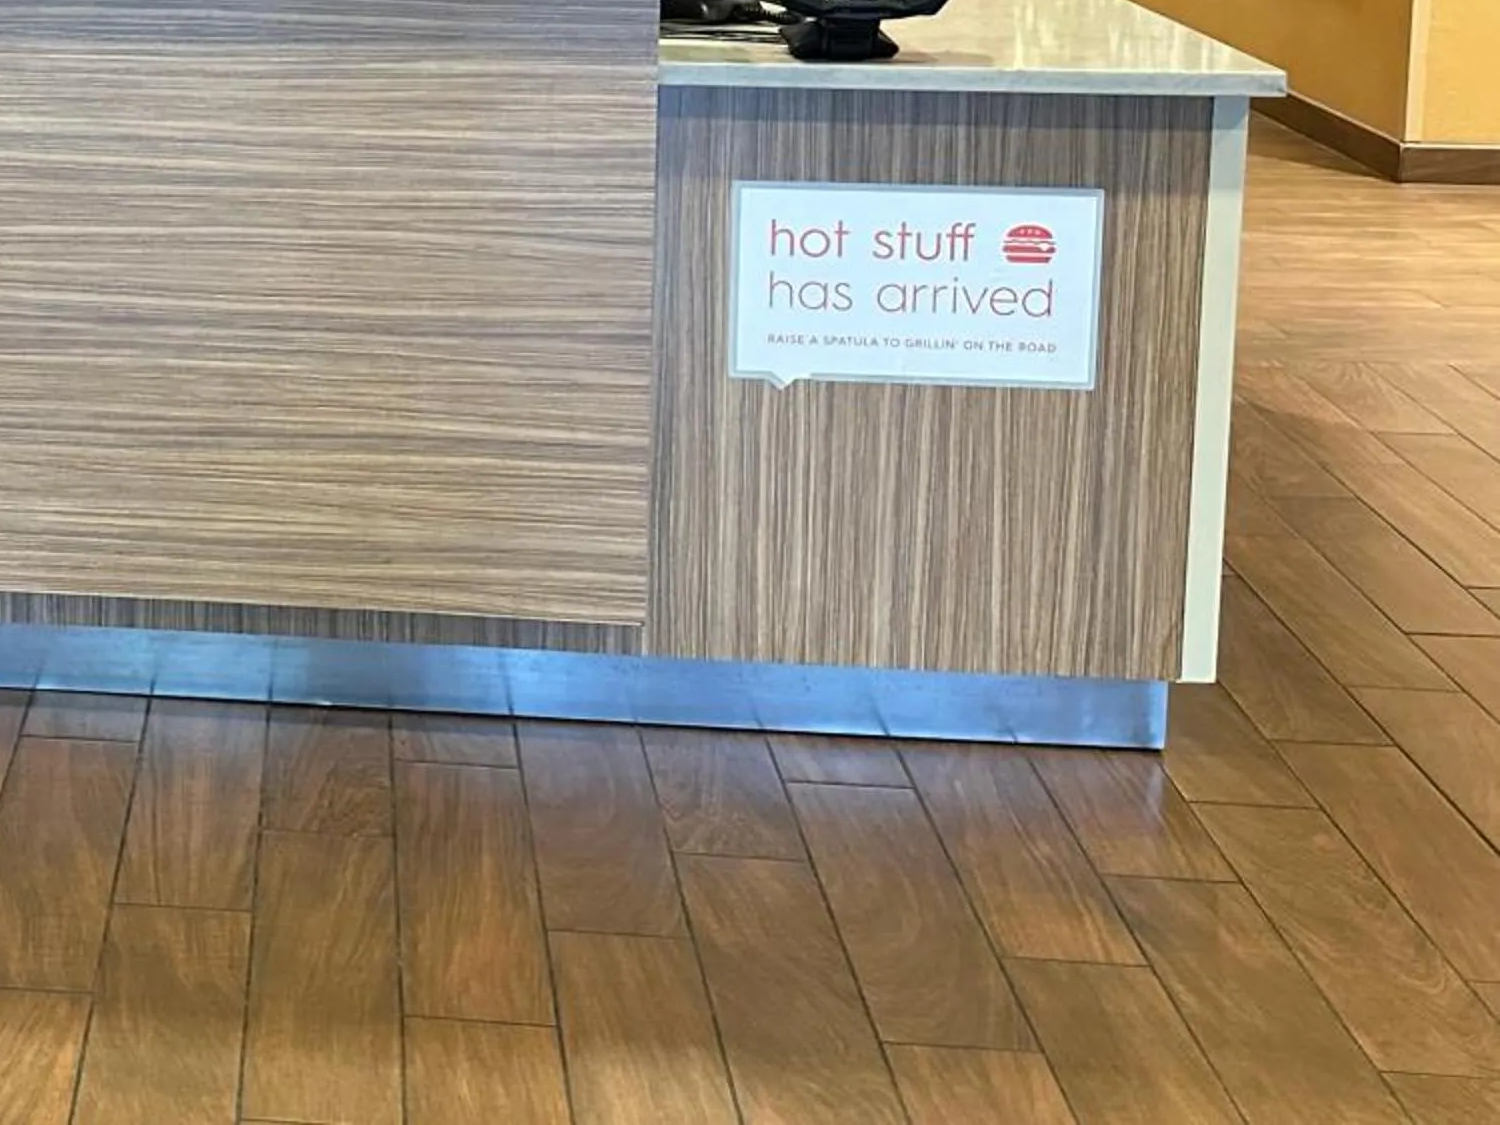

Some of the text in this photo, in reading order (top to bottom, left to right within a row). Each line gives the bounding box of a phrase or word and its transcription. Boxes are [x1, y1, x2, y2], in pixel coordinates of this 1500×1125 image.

[770, 218, 977, 261] hot stuff
[769, 270, 1053, 318] has arrived
[767, 333, 805, 345] RAISE
[808, 334, 819, 345] A
[823, 335, 879, 348] SPATULA
[883, 337, 901, 348] TO
[963, 340, 983, 351] ON
[988, 341, 1013, 352] THE
[1018, 342, 1058, 354] ROAD
